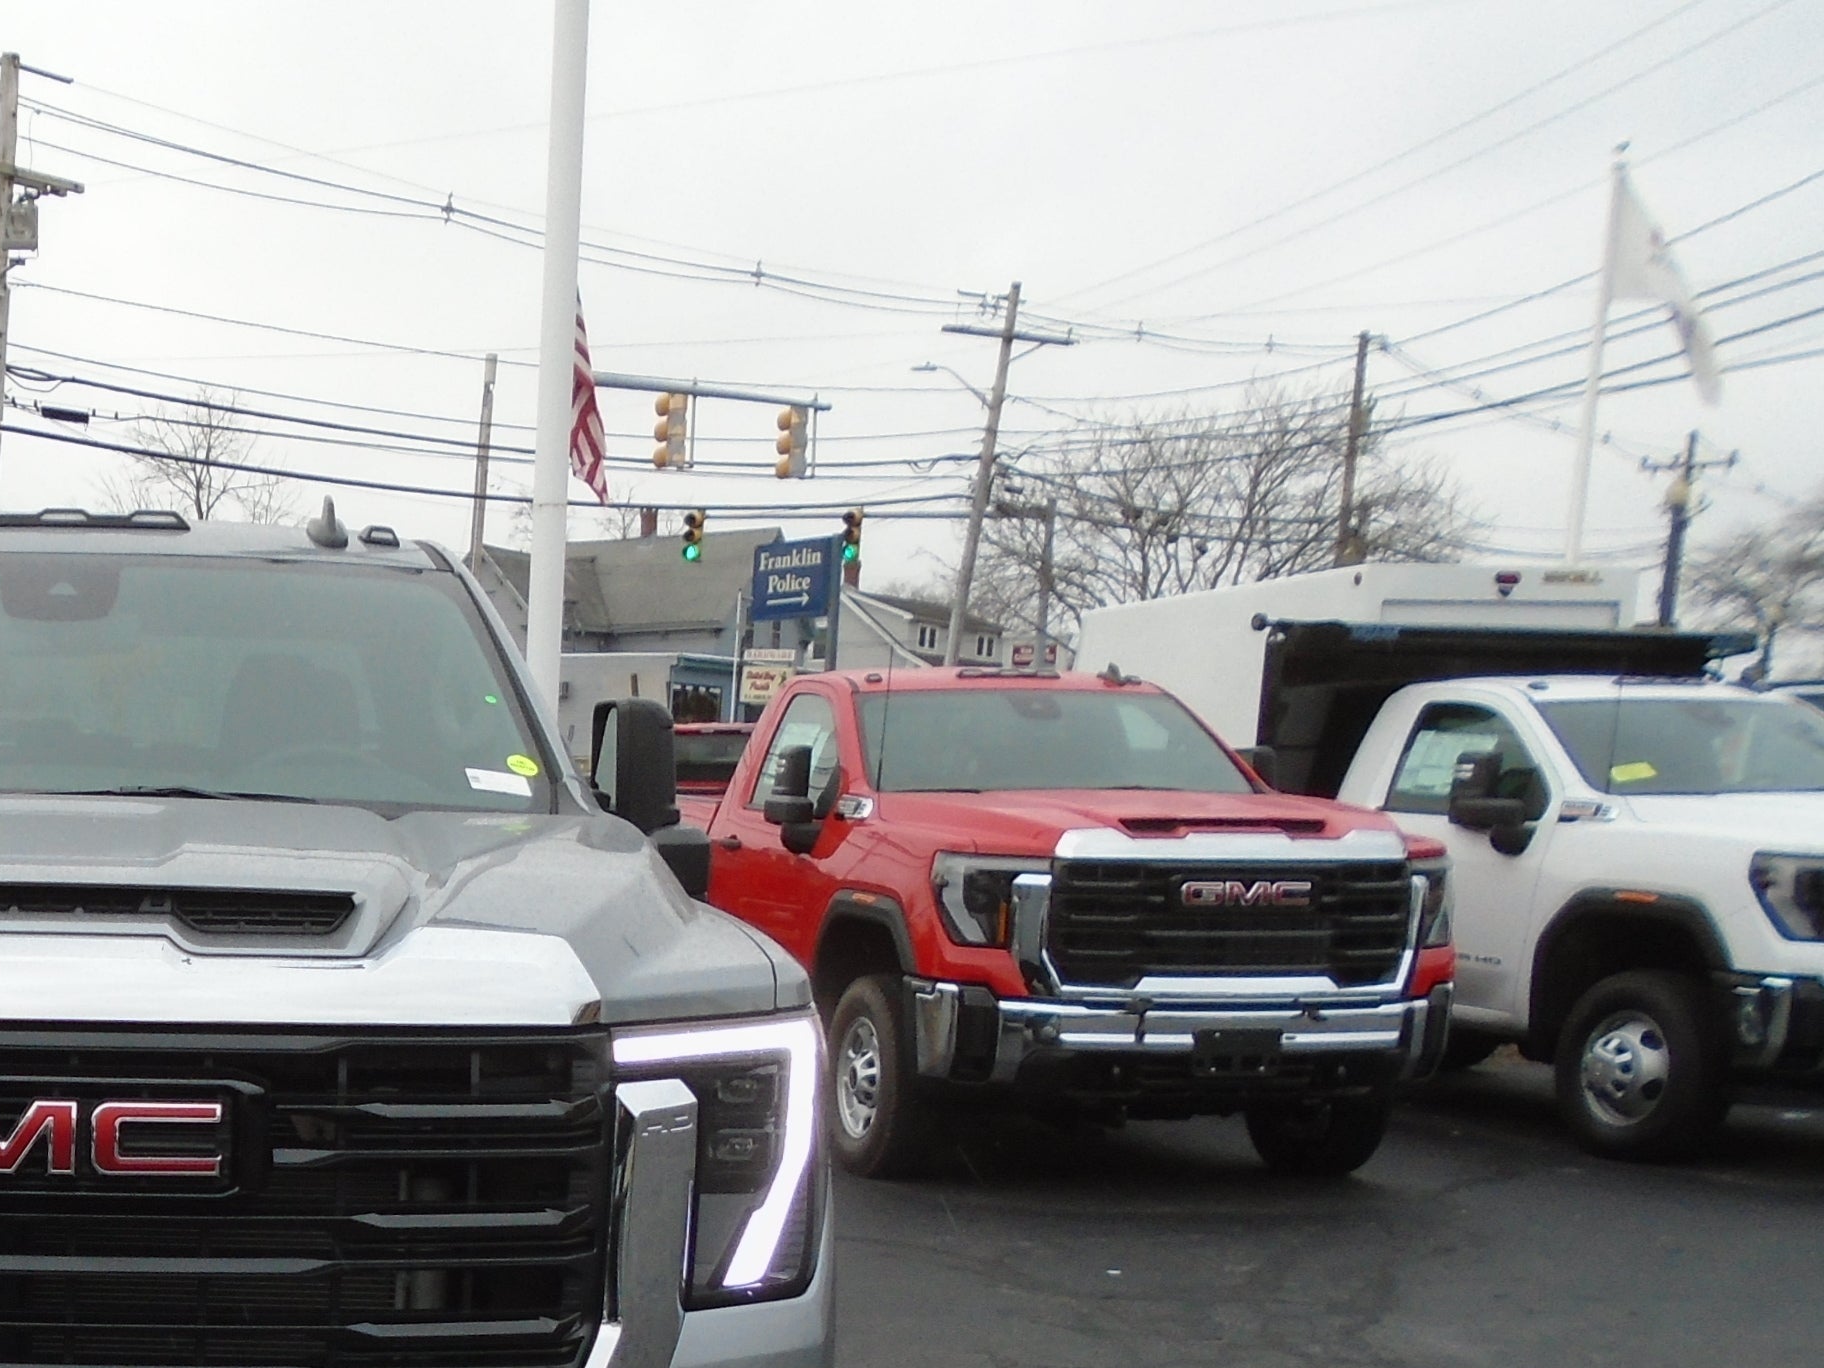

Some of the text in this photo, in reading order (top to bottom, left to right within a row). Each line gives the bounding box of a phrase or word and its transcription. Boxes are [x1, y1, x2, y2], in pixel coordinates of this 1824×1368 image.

[759, 548, 822, 571] Franklin
[767, 573, 811, 594] Police
[1181, 881, 1312, 906] GMC
